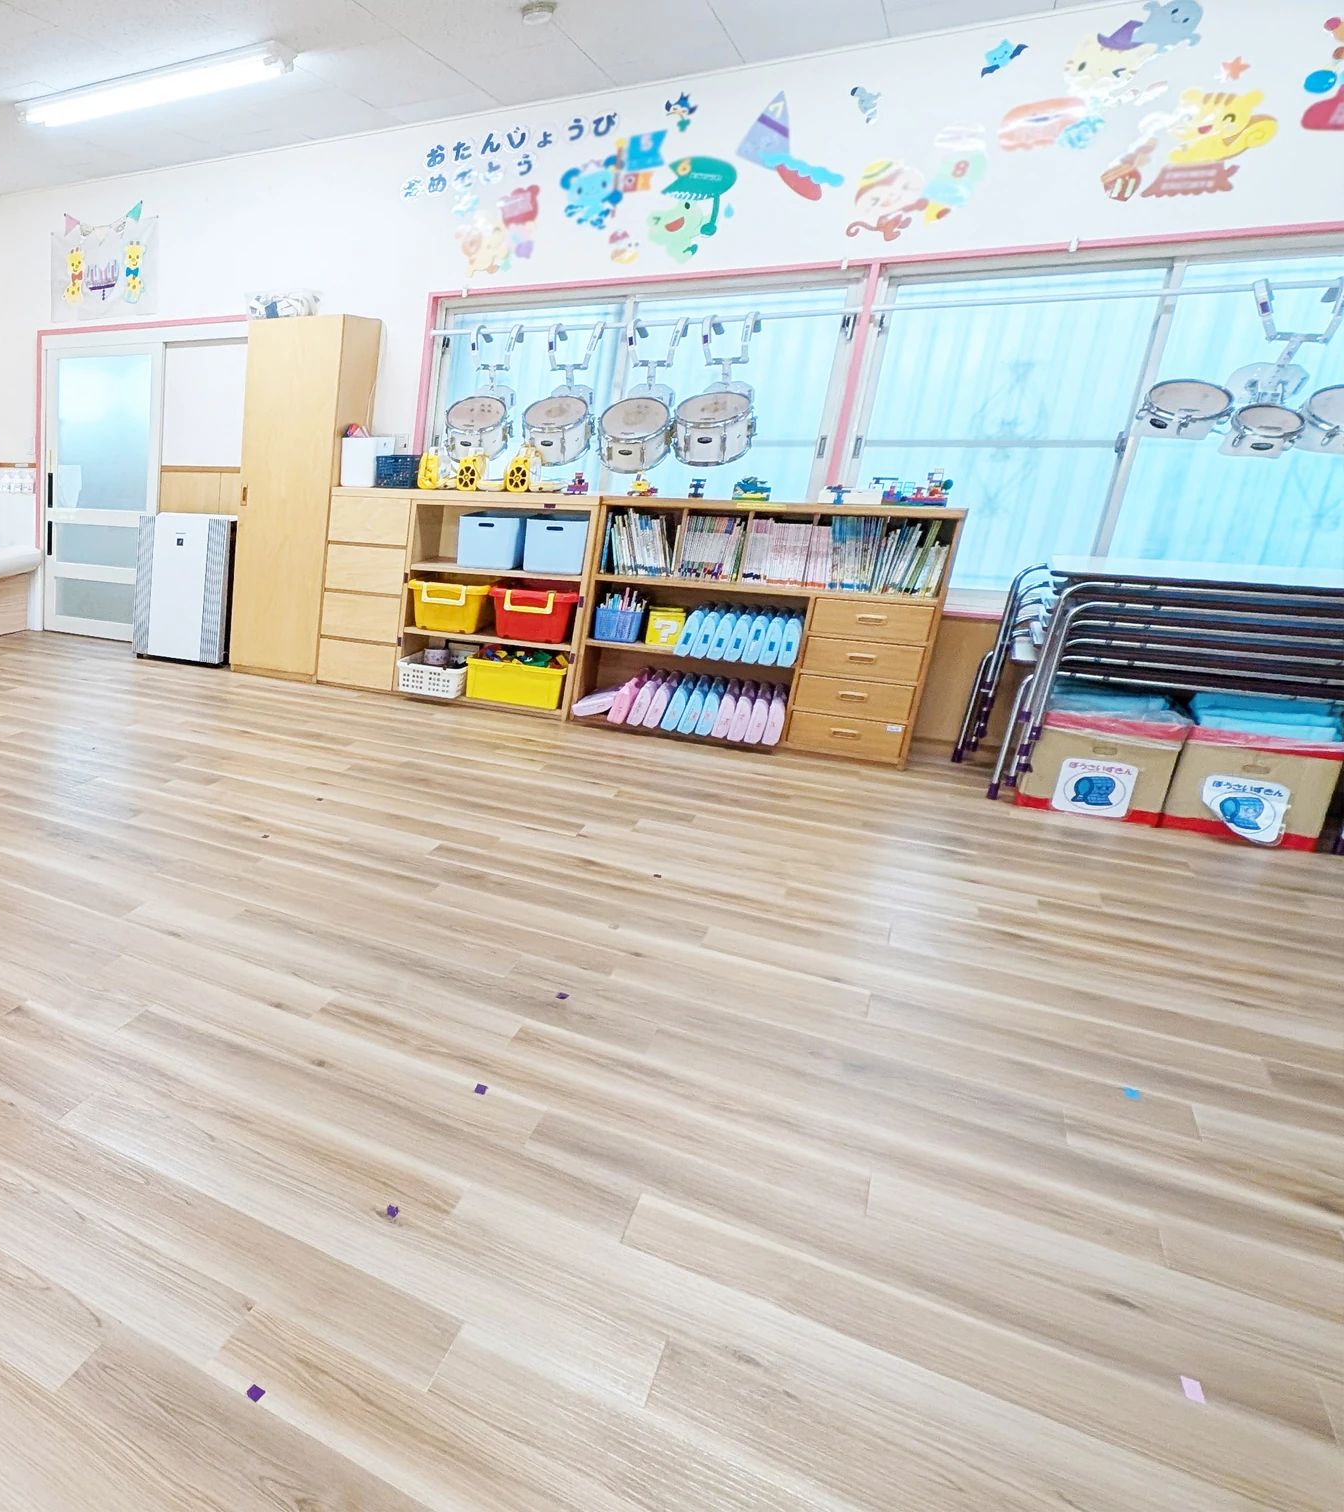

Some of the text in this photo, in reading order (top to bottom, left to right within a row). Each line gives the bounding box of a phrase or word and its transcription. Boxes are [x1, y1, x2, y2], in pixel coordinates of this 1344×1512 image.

[426, 112, 617, 168] おたんじょうび
[952, 160, 969, 178] 8
